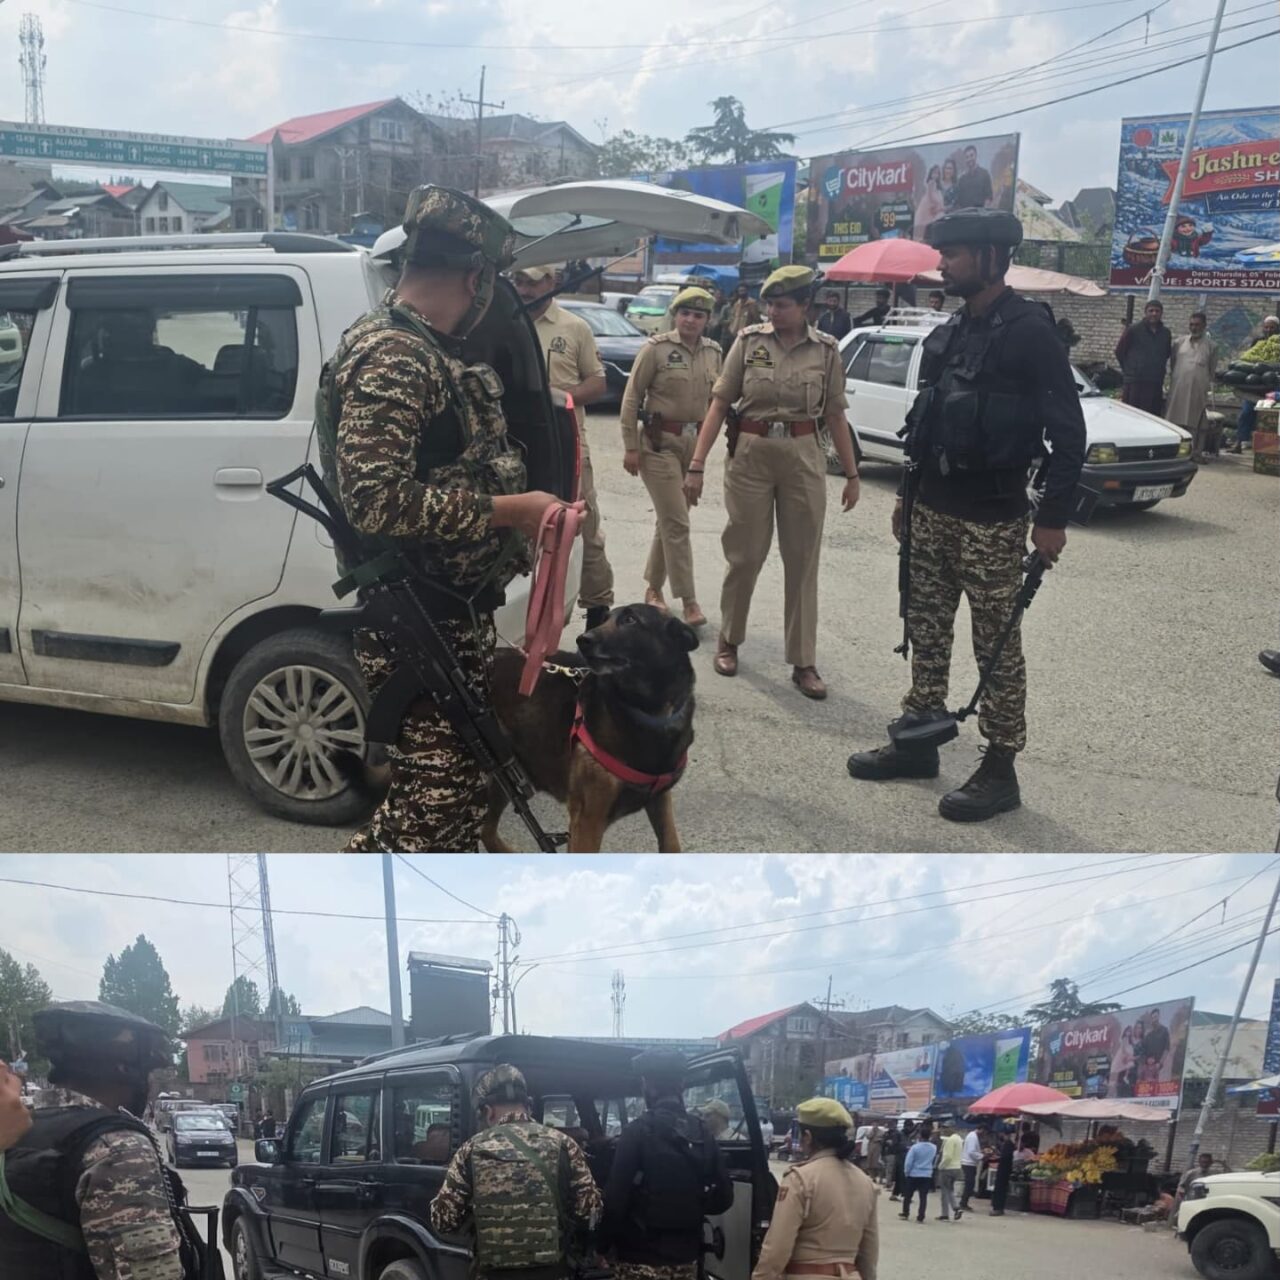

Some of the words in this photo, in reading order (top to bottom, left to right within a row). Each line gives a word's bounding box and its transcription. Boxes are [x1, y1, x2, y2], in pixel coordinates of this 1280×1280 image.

[847, 163, 907, 192] Citykart
[1185, 278, 1237, 287] SPORTS
[1064, 1025, 1108, 1049] Citykart
